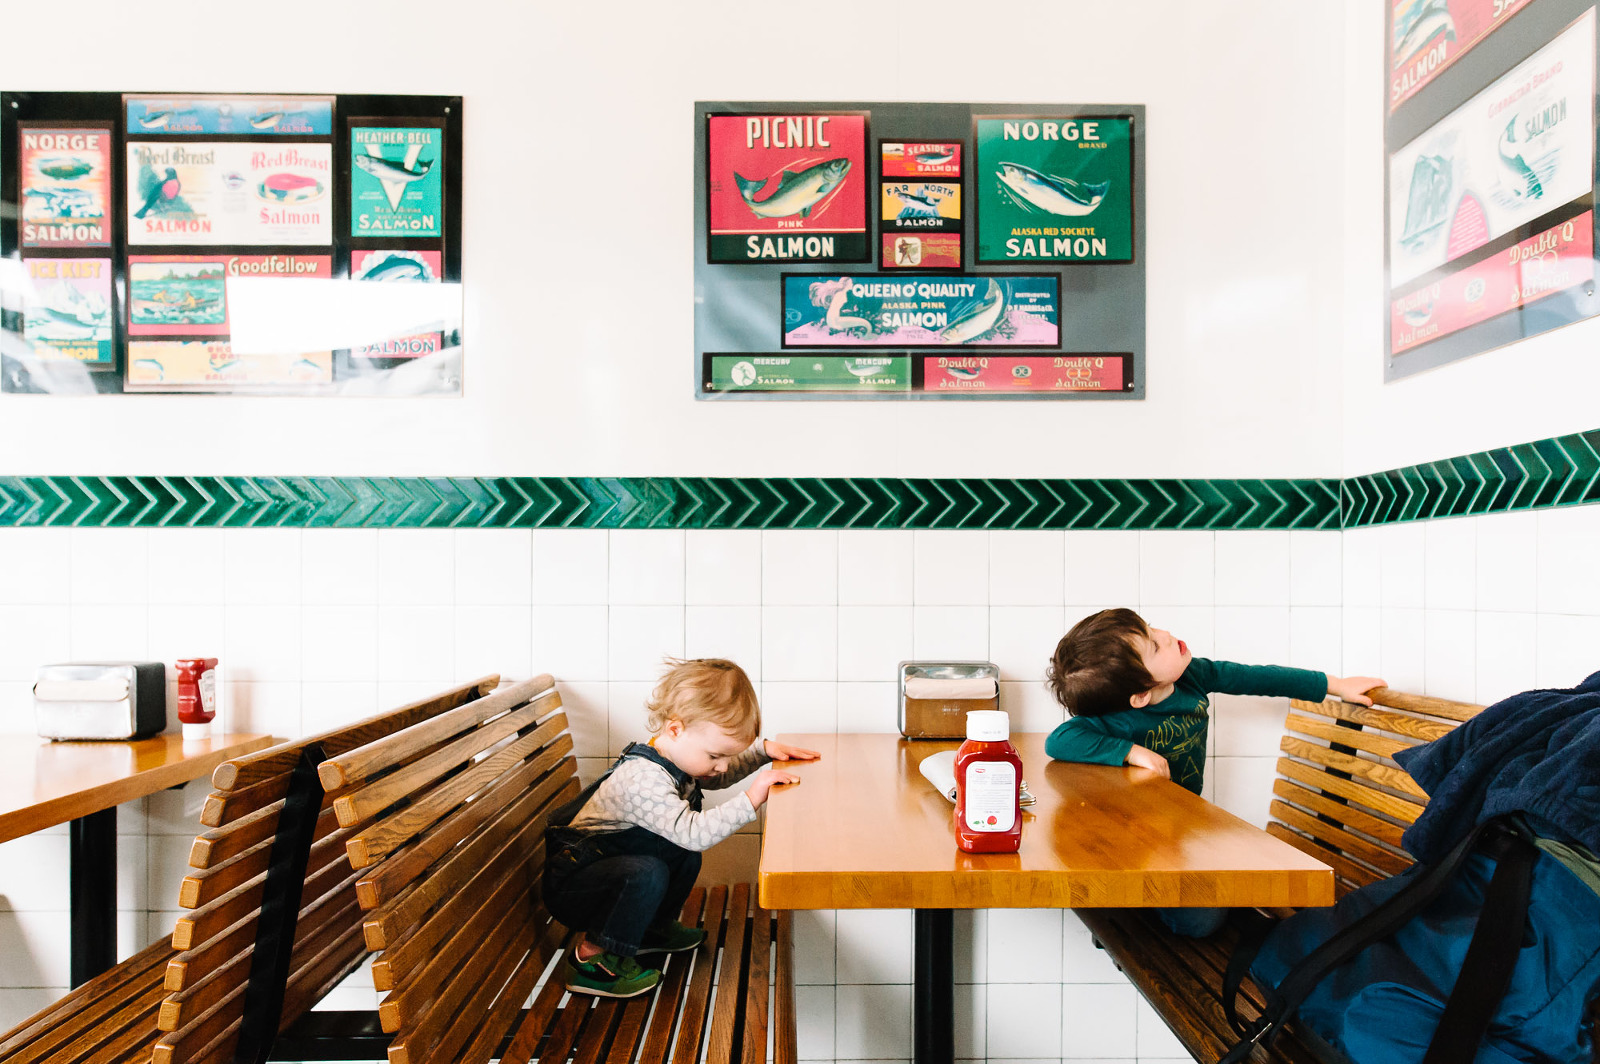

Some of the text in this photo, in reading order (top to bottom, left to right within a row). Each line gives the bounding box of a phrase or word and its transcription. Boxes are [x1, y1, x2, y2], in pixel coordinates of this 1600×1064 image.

[1392, 38, 1447, 101] SALMON
[1532, 61, 1563, 89] BRAND
[1525, 97, 1567, 142] SALMON
[746, 116, 831, 149] PICNIC
[1003, 122, 1100, 141] NORGE
[24, 134, 100, 151] NORGE
[907, 144, 945, 156] SEASIDE
[172, 146, 215, 165] Breast
[251, 148, 329, 171] Red Breast
[917, 164, 960, 172] SALMON
[886, 184, 954, 197] FAR NORTH
[259, 207, 321, 225] Salmon
[359, 213, 435, 230] SALMON
[777, 220, 804, 228] PINK
[896, 218, 944, 227] SALMON
[24, 225, 103, 242] SALMON
[145, 219, 212, 233] SALMON
[1011, 227, 1096, 236] ALASKA RED SOCKEYE
[747, 235, 834, 258] SALMON
[1005, 238, 1107, 257] SALMON
[1508, 230, 1558, 266] Double
[30, 261, 102, 279] ICE KIST
[228, 255, 318, 277] Goodfellow
[852, 283, 901, 298] QUEEN
[918, 283, 976, 298] QUALITY
[881, 302, 946, 310] ALASKA PINK
[881, 312, 948, 328] SALMON
[1397, 322, 1439, 347] Salmon
[938, 357, 977, 368] Double
[1053, 357, 1092, 368] Double
[939, 378, 986, 388] Salmon
[1055, 378, 1101, 388] Salmon
